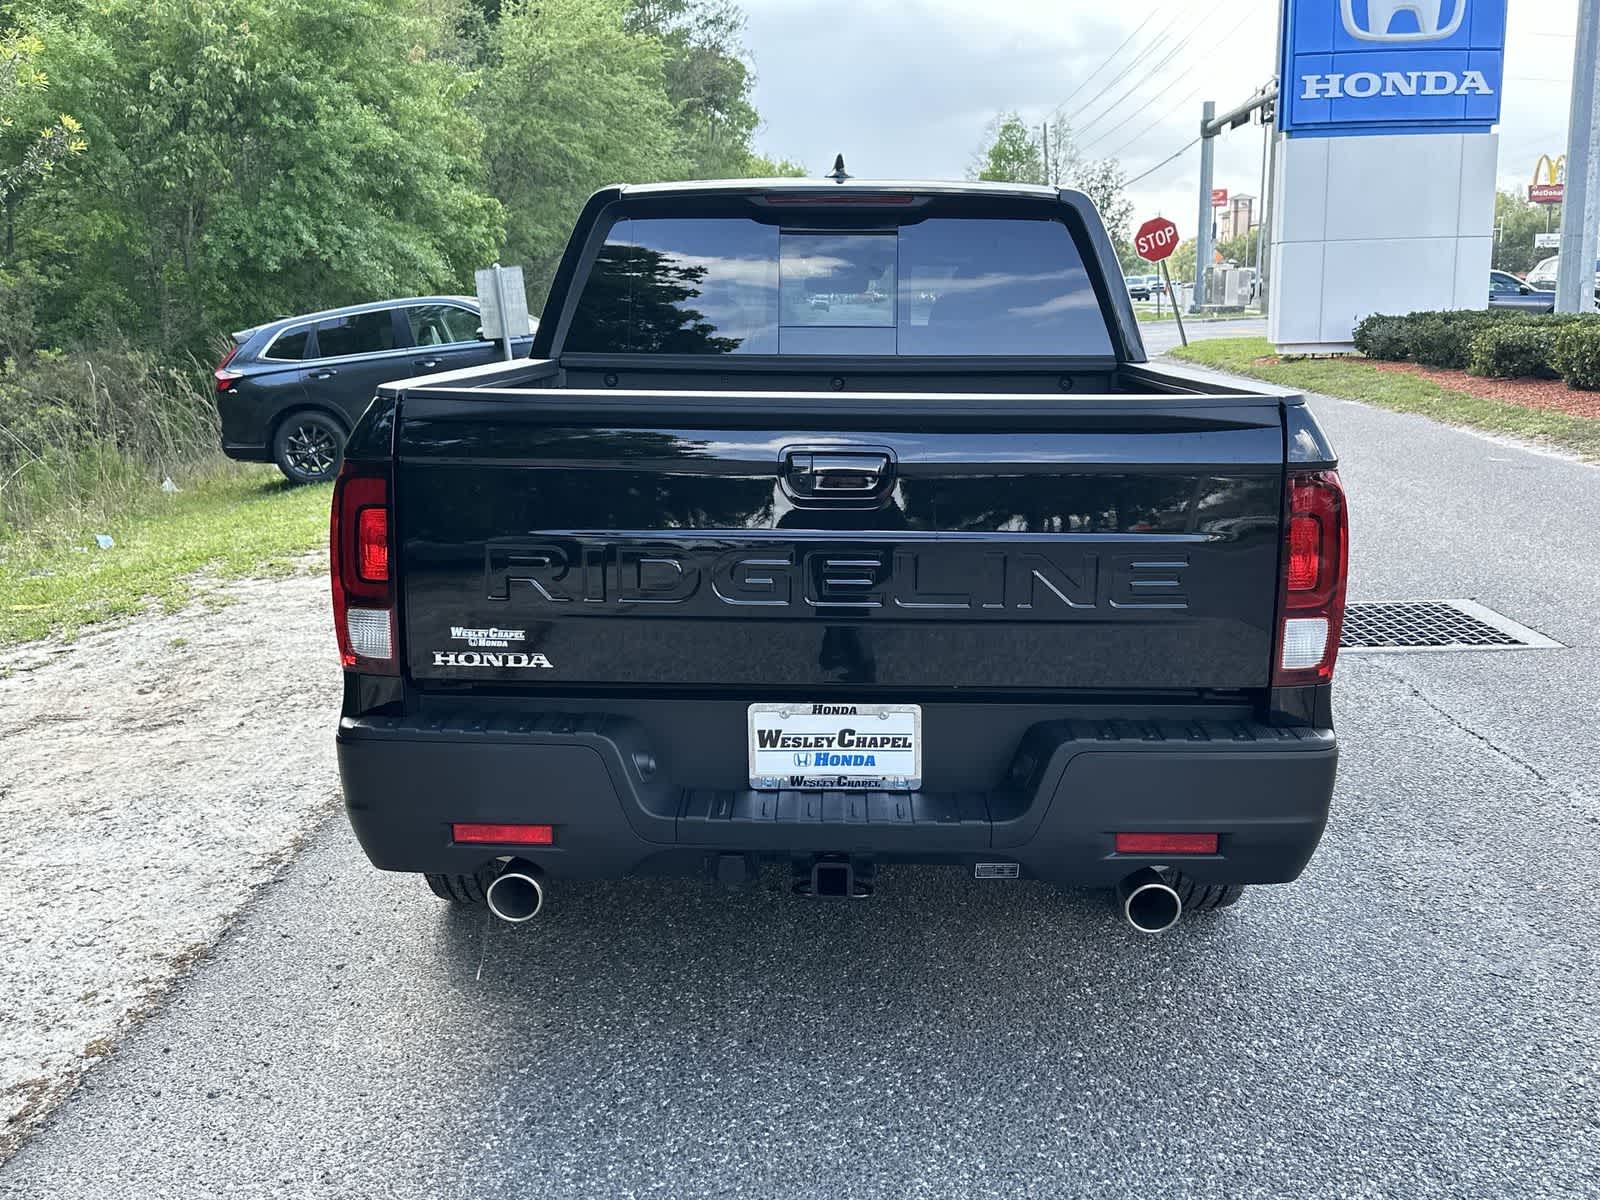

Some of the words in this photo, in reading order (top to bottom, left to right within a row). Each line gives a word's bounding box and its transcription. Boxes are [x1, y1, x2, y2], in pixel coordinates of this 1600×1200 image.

[1301, 71, 1494, 99] HONDA
[1531, 189, 1563, 197] McDonal
[1138, 226, 1174, 253] STOP
[485, 542, 1190, 609] RIDGELINE
[450, 626, 488, 638] WESLEY
[489, 627, 525, 639] CHAPEL
[478, 639, 508, 647] HONDA
[432, 651, 554, 668] HONDA
[812, 704, 857, 715] HONDA
[757, 729, 836, 748] WESLEY
[837, 728, 912, 748] CHAPEL
[814, 752, 876, 767] HONDA
[790, 775, 837, 787] WESLEY
[837, 775, 881, 787] CHAPEL
